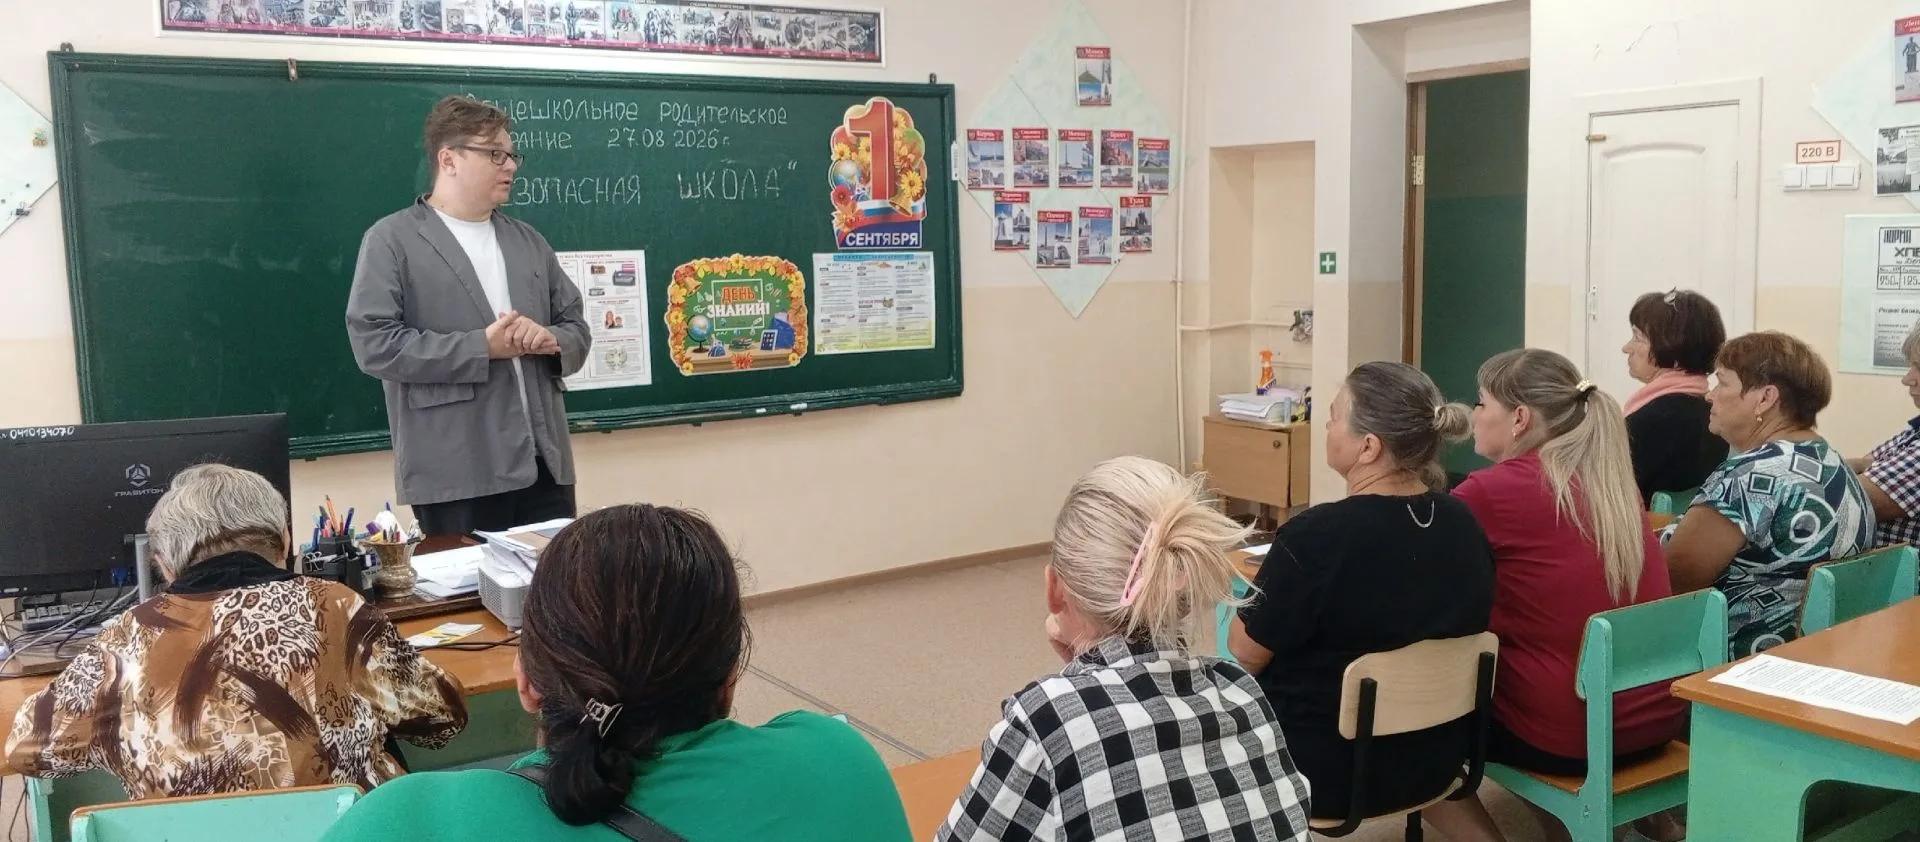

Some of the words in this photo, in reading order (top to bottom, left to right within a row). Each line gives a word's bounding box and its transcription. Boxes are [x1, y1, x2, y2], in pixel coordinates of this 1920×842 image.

[849, 100, 895, 200] 1
[1801, 147, 1822, 158] 220
[513, 174, 640, 206] ЗОПАСНАЯ
[845, 232, 919, 246] СЕНТЯБРЯ
[722, 286, 756, 304] ДЕНЬ
[706, 300, 770, 318] ЗНАНИЙ!
[115, 488, 164, 497] ГРАВИТОН
